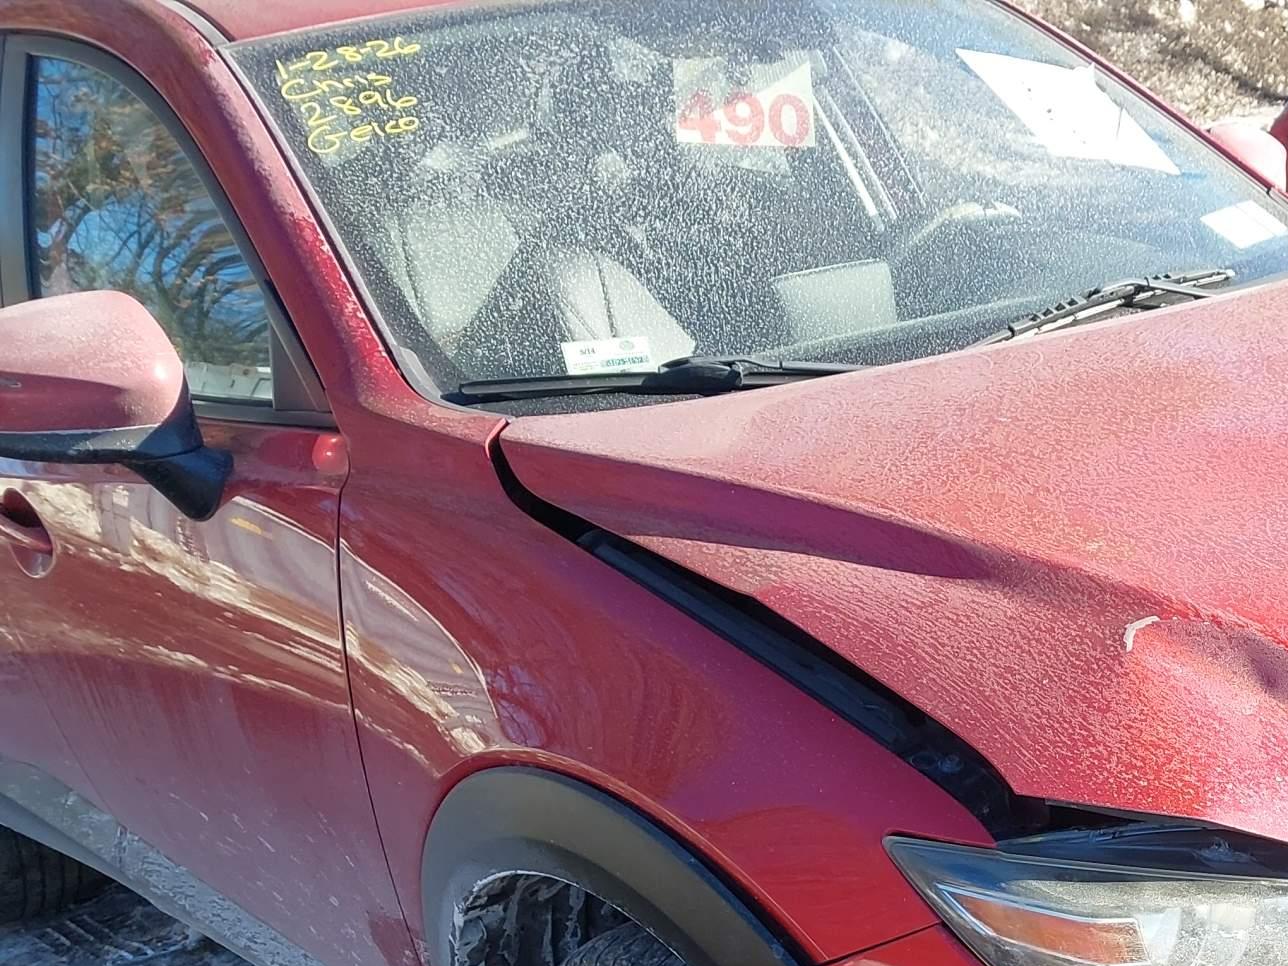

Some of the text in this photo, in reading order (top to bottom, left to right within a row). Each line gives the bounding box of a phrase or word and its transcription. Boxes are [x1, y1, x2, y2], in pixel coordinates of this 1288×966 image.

[275, 36, 421, 79] 1-28-26
[301, 89, 418, 126] 2896
[678, 88, 811, 146] 490
